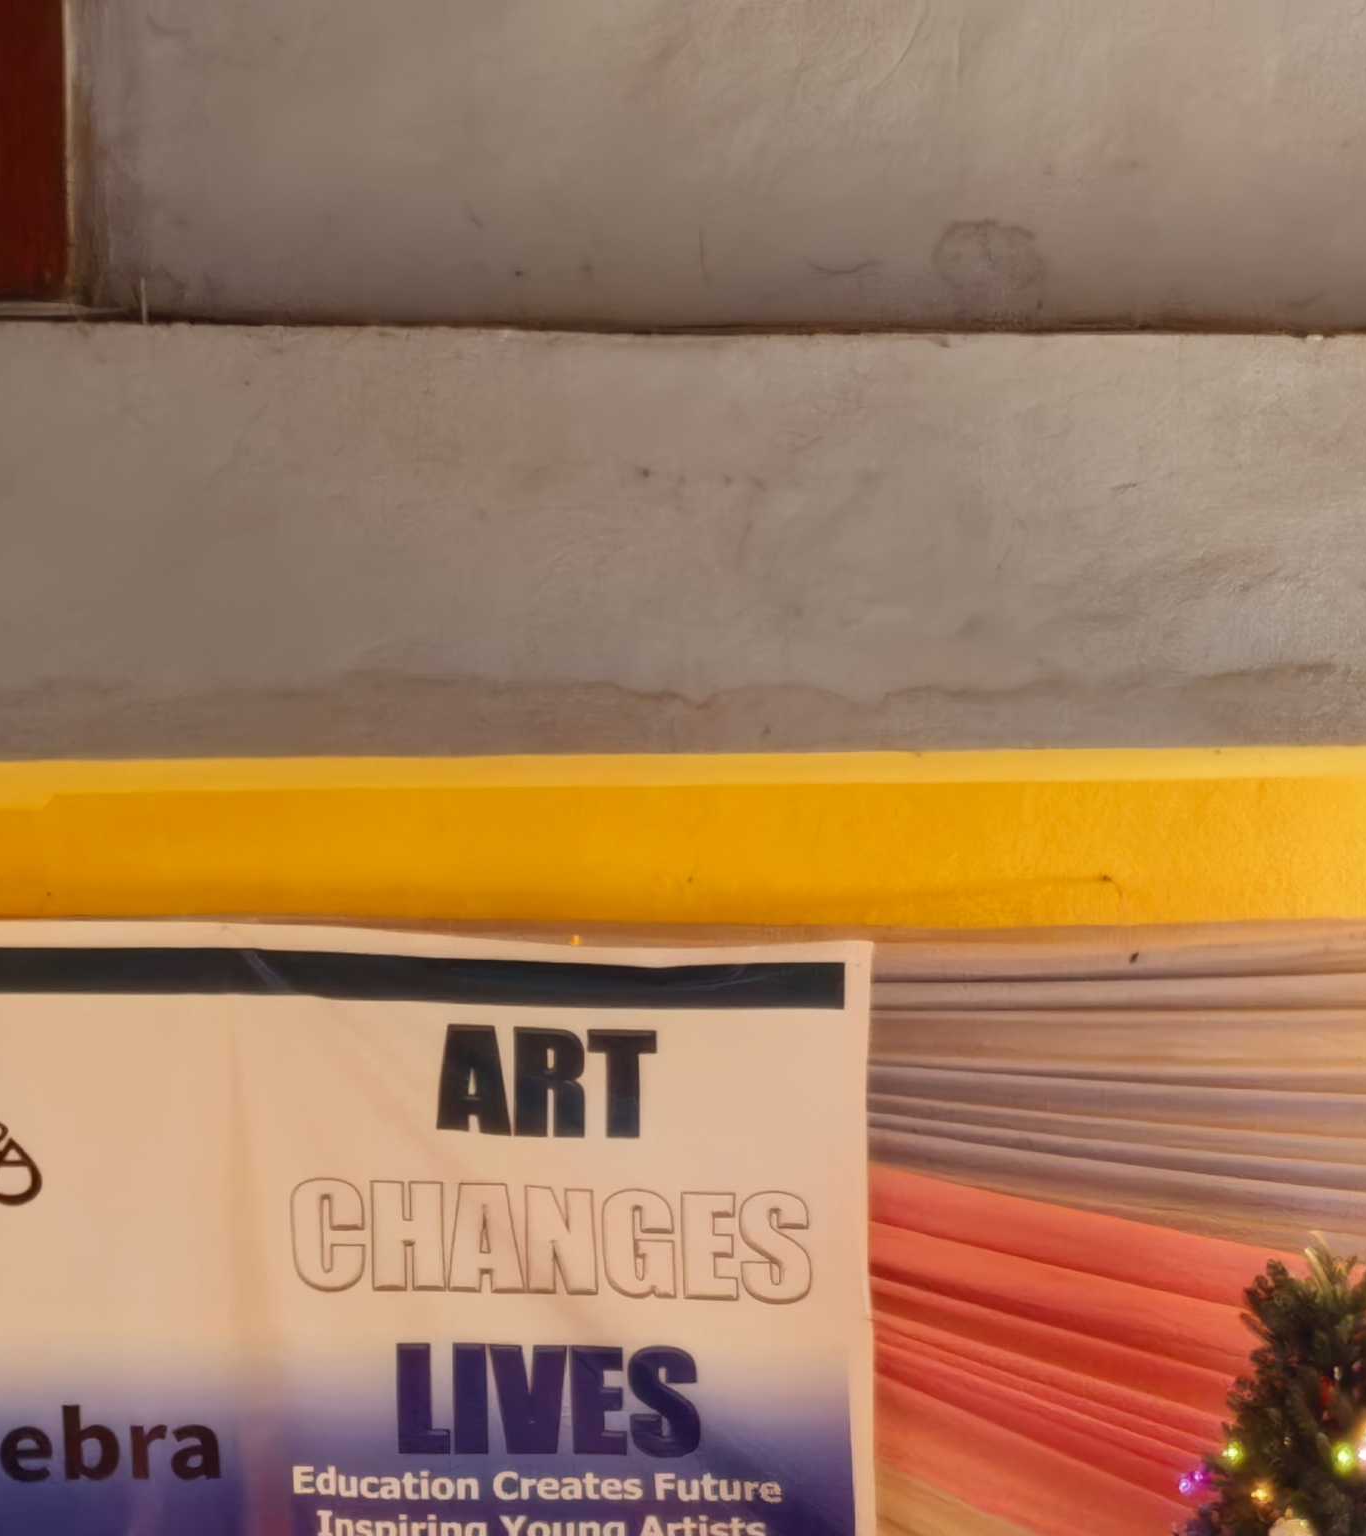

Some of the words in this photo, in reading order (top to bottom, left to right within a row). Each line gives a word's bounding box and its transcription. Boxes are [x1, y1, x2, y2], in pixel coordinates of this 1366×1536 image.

[436, 1024, 657, 1138] ART
[291, 1178, 812, 1304] CHANGES
[396, 1343, 701, 1458] LIVES
[292, 1465, 479, 1500] Education
[493, 1471, 643, 1501] Creates
[654, 1473, 782, 1503] Future
